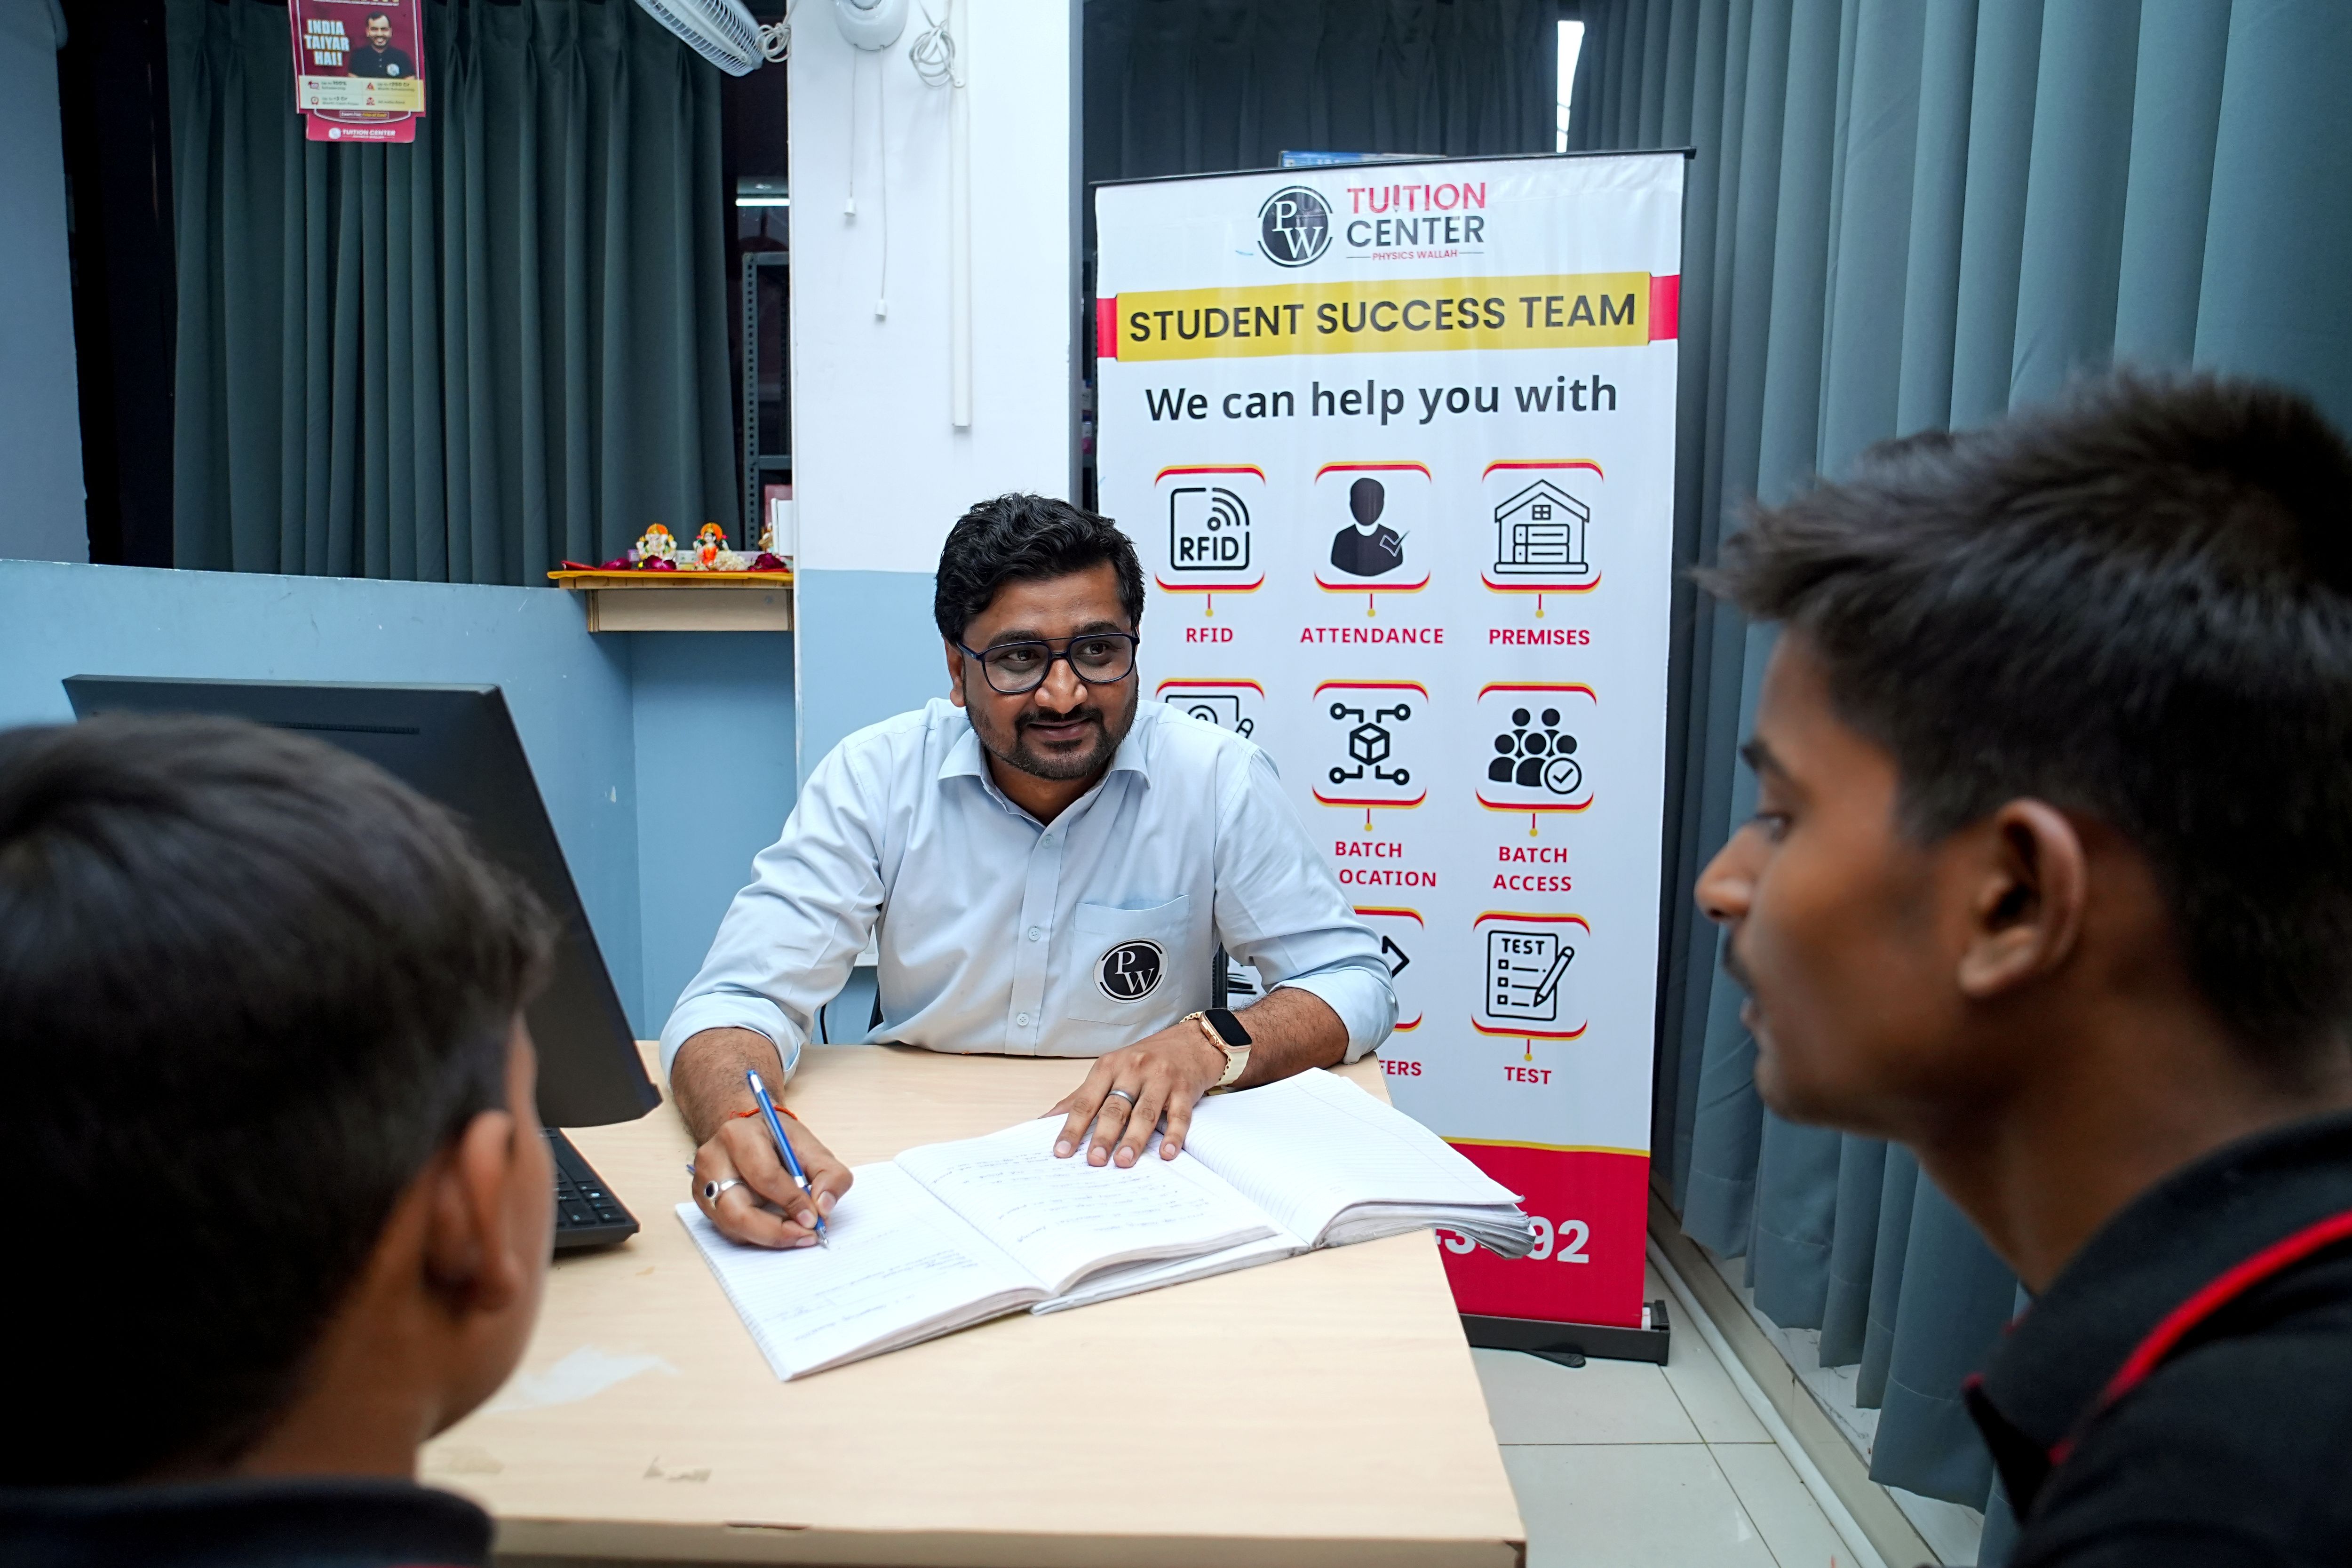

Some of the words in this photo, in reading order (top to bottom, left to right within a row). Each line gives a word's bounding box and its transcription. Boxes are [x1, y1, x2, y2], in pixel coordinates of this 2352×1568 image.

[307, 19, 345, 35] INDIA
[303, 35, 350, 51] TAIYAR
[1349, 183, 1485, 213] TUITION
[1271, 200, 1325, 261] PW
[1347, 215, 1484, 246] CENTER
[1372, 251, 1414, 261] PHYSICS
[1416, 249, 1458, 259] WALLAH
[1130, 303, 1304, 342] STUDENT
[1317, 297, 1505, 334] SUCCESS
[1519, 293, 1635, 328] TEAM
[1145, 388, 1208, 421] We
[1223, 390, 1294, 419] can
[1312, 379, 1404, 426] help
[1418, 386, 1499, 425] you
[1514, 374, 1616, 412] with
[1180, 536, 1239, 561] RFID
[1186, 627, 1233, 643] RFID
[1301, 627, 1444, 644] ATTENDANCE
[1489, 629, 1590, 645] PREMISES
[1335, 841, 1402, 858] BATCH
[1499, 846, 1568, 863] BATCH
[1339, 868, 1437, 887] OCATION
[1493, 874, 1572, 892] ACCESS
[1501, 938, 1545, 955] TEST
[1114, 950, 1156, 995] PW
[1504, 1066, 1551, 1085] TEST
